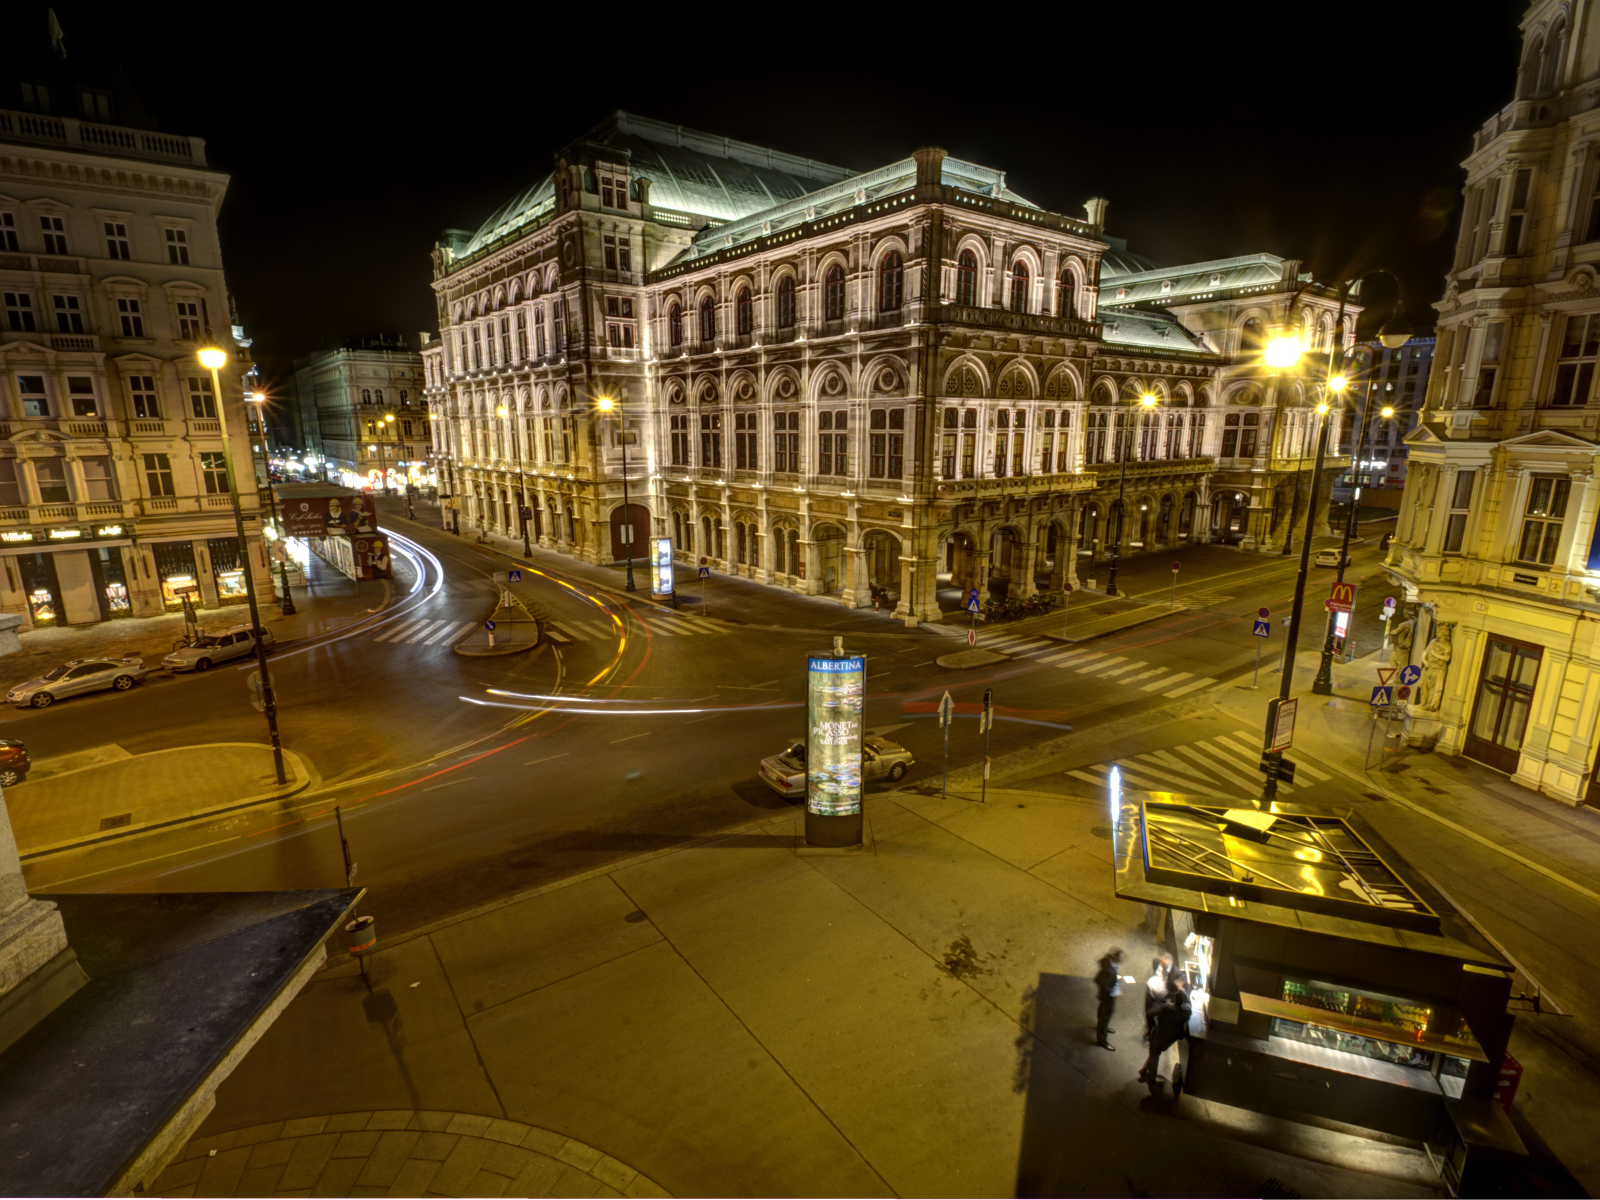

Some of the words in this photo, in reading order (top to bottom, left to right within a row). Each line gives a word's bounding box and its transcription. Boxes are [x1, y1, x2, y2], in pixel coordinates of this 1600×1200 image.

[1, 532, 33, 542] Wilhelm
[810, 660, 862, 671] ALBERTINA
[1279, 711, 1294, 719] KASSEN
[820, 721, 852, 730] MONET
[813, 726, 850, 736] PICASSO
